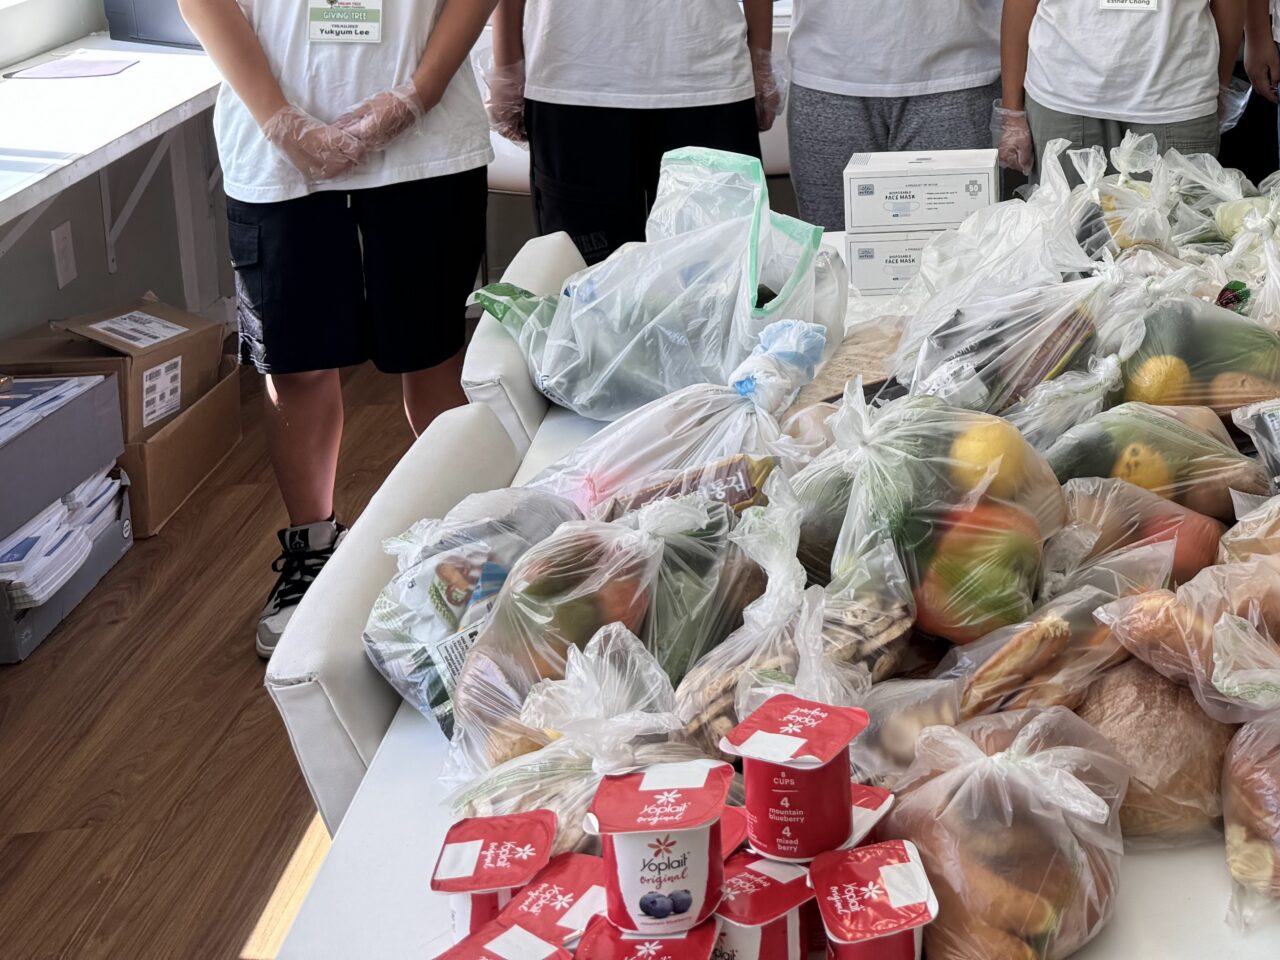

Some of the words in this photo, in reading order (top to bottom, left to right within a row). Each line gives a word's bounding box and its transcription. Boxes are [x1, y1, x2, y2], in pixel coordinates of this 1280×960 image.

[323, 11, 349, 20] GIVING
[351, 12, 366, 20] TREE
[320, 28, 353, 36] Yukyum
[773, 777, 795, 785] CUPS
[780, 796, 790, 808] 4
[640, 803, 687, 816] Yoplait
[769, 807, 804, 816] mountain
[636, 812, 683, 825] original
[768, 813, 805, 823] blueberry
[782, 826, 791, 837] 4
[776, 837, 799, 845] mixed
[777, 844, 797, 853] berry
[496, 841, 517, 869] Yoplait
[640, 853, 688, 875] Yoplait
[640, 868, 689, 889] original
[529, 884, 564, 916] Yoplait
[826, 886, 851, 915] original
[843, 882, 867, 913] Yoplait
